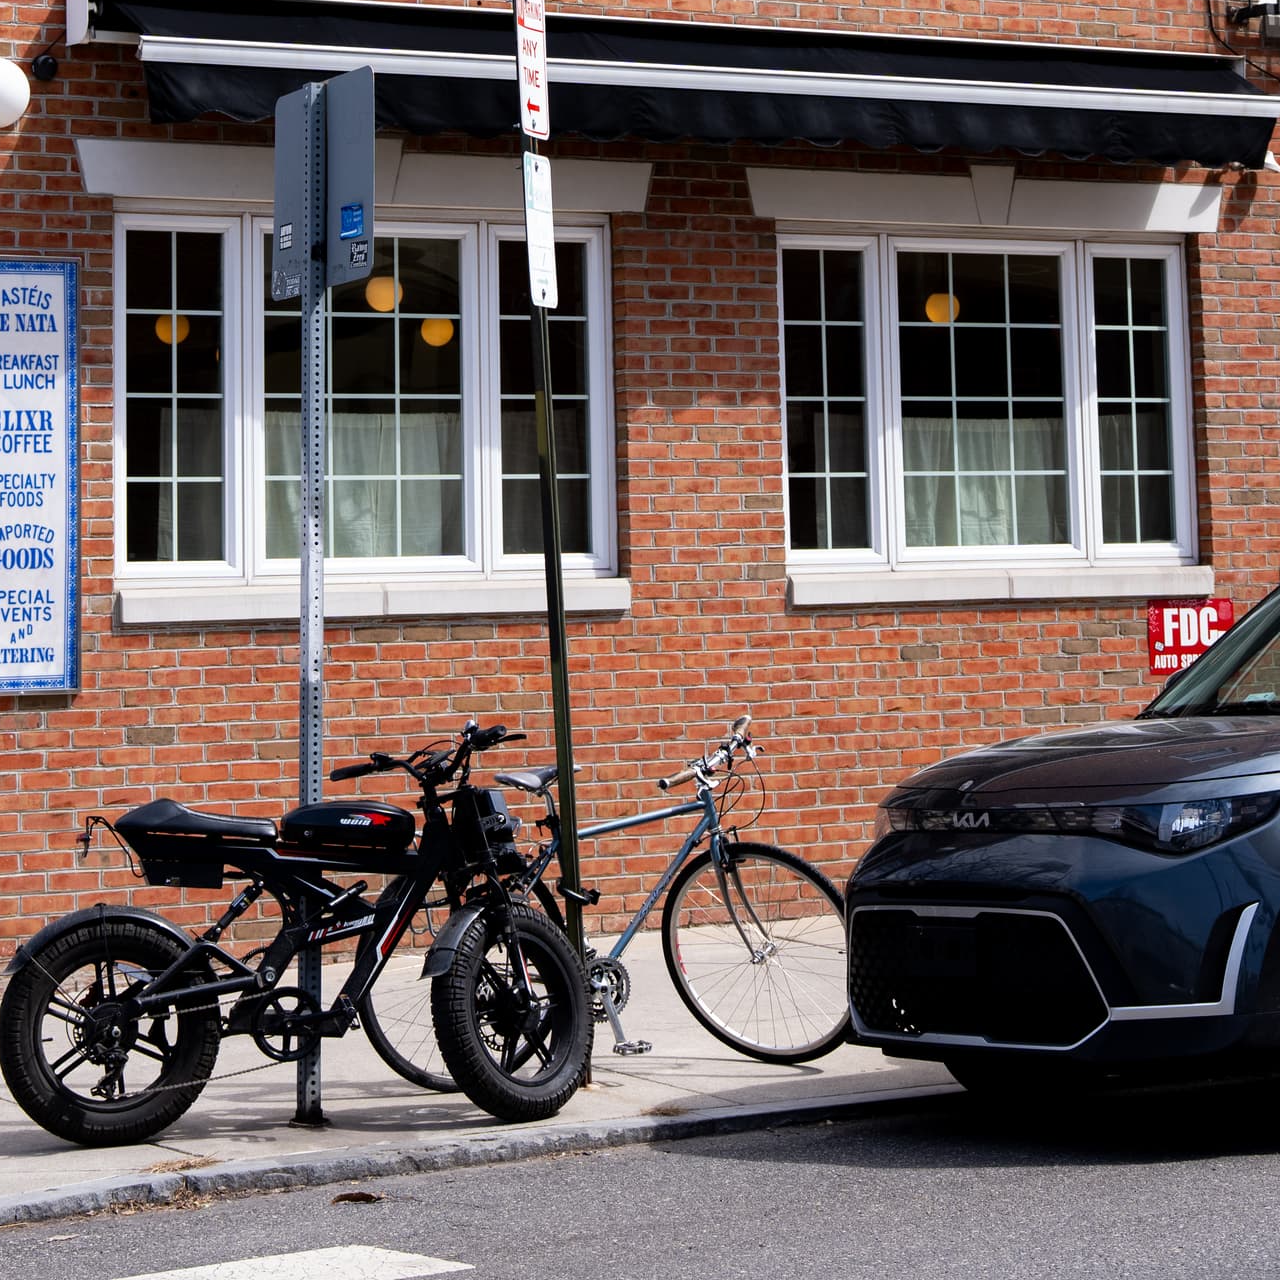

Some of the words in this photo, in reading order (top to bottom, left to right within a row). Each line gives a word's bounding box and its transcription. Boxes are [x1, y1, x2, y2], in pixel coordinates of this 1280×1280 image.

[522, 38, 538, 58] ANY
[523, 67, 540, 88] TIME
[15, 313, 58, 332] NATA
[4, 373, 55, 389] LUNCH
[0, 491, 44, 507] FOODS
[10, 623, 33, 644] AND
[1154, 654, 1178, 669] AUTO
[952, 812, 990, 828] KIA
